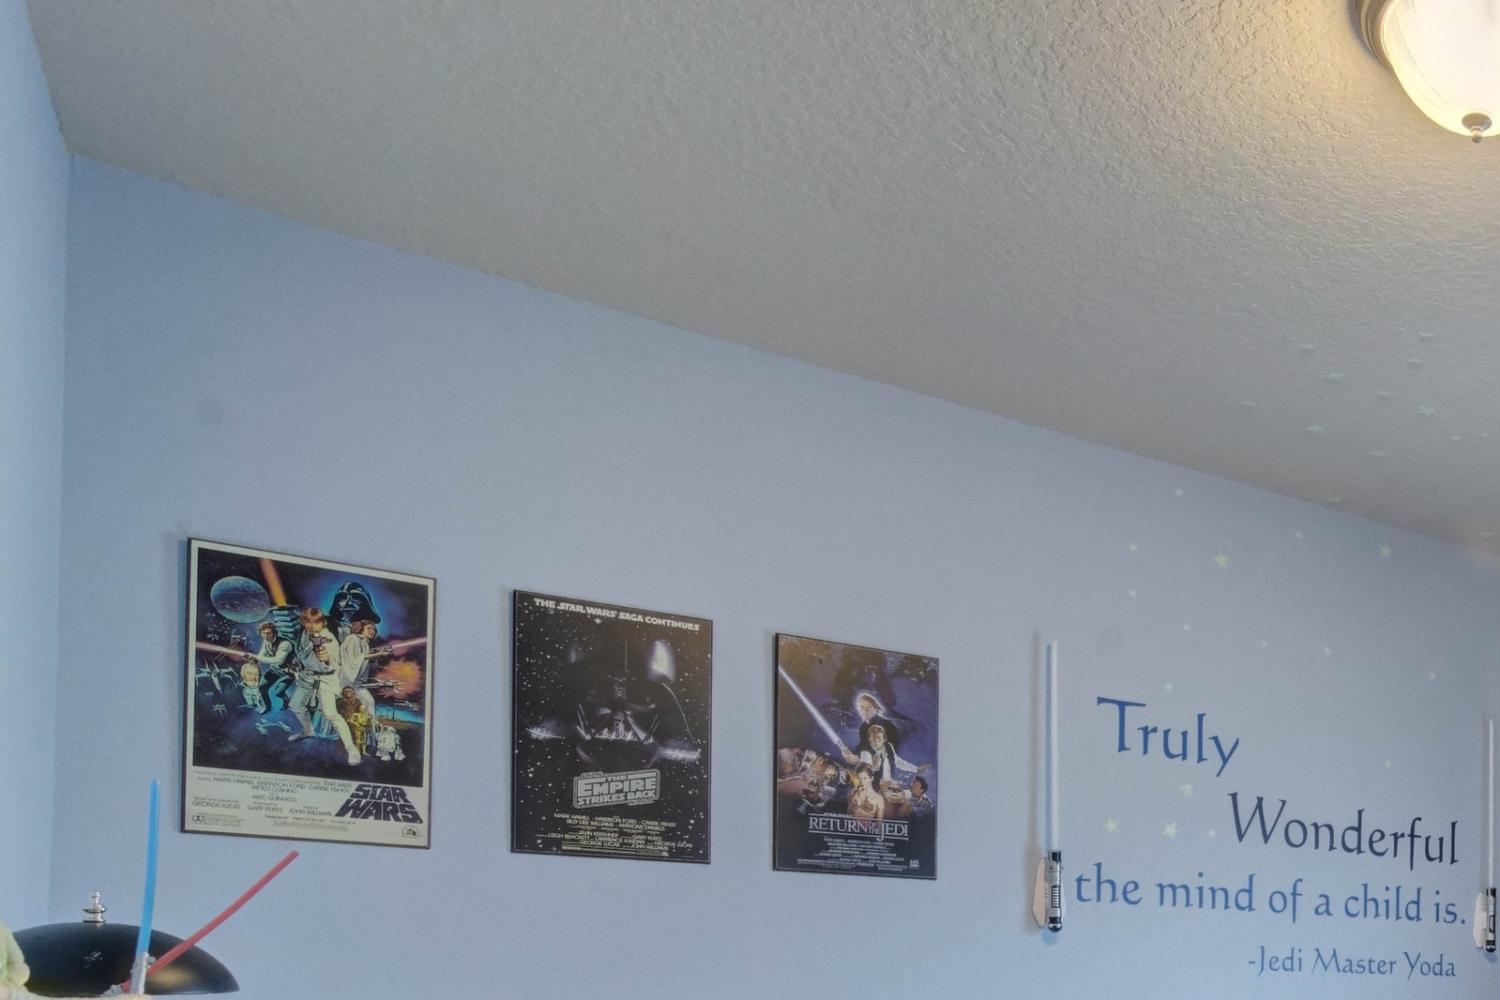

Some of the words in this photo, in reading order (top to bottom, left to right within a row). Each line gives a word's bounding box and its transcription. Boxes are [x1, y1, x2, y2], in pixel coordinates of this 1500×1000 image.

[534, 598, 556, 609] THE
[557, 602, 586, 614] STAR
[586, 606, 618, 618] WARS
[618, 612, 644, 623] SAGA
[644, 616, 701, 631] CONTINUES
[1096, 695, 1240, 778] Truly
[350, 784, 412, 803] STAR
[577, 777, 656, 797] EMPIRE
[577, 793, 626, 805] STRIKES
[626, 789, 656, 800] BACK
[335, 799, 423, 824] WARS
[808, 817, 868, 834] RETURN
[876, 822, 909, 841] JEDI
[1226, 791, 1459, 872] Wonderful
[1074, 861, 1143, 906] the
[1154, 871, 1257, 913] mind
[1268, 877, 1304, 924] of
[1313, 893, 1334, 917] a
[1343, 882, 1423, 923] child
[1433, 889, 1466, 925] is.
[1248, 944, 1303, 977] -Jedi
[1312, 947, 1397, 976] Master
[1402, 951, 1457, 981] Yoda
